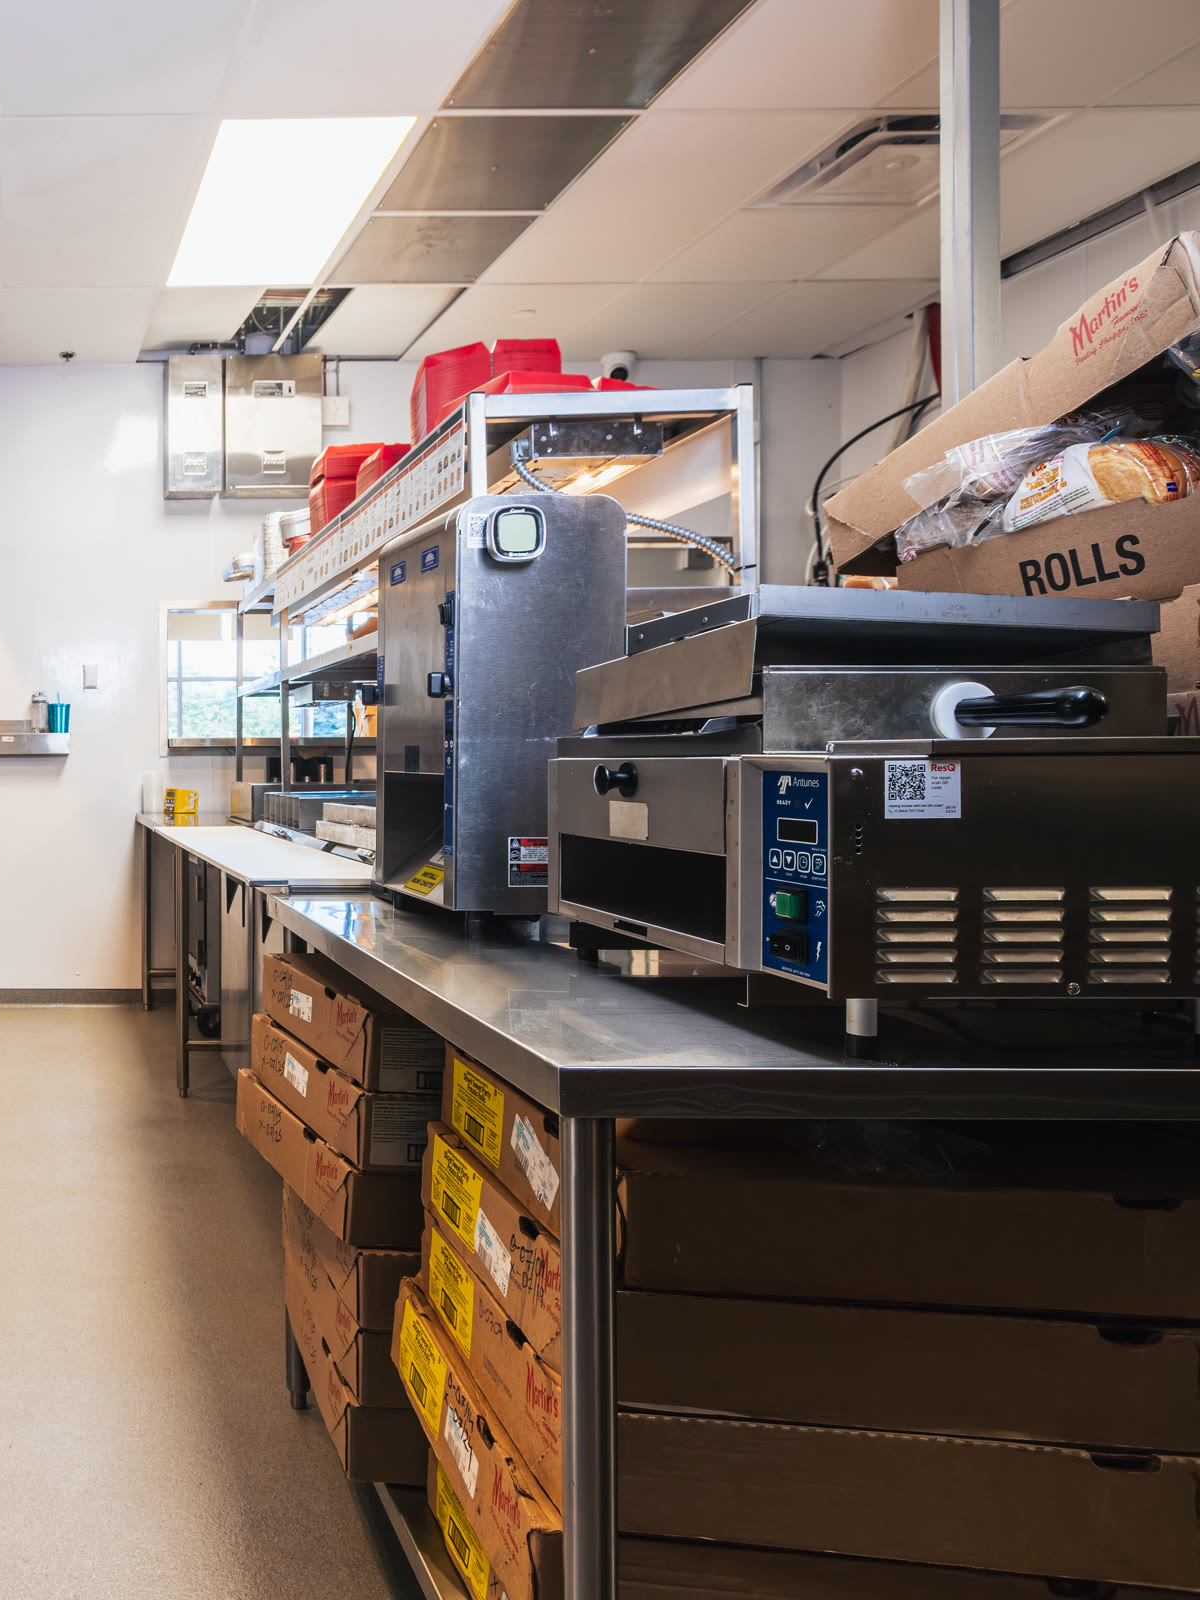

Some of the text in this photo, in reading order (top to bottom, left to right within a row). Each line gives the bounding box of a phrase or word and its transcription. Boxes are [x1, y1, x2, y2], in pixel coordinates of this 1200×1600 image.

[1069, 277, 1139, 357] Martin's
[1018, 534, 1146, 597] ROLLS
[931, 763, 956, 772] ResQ
[792, 777, 820, 788] Antunes
[419, 880, 435, 888] CHUTE
[421, 871, 439, 880] INSTALL
[336, 1001, 357, 1029] Martin's
[327, 1080, 349, 1108] Martin's
[315, 1151, 338, 1180] Martin's
[526, 1361, 559, 1418] Martin's
[492, 1463, 520, 1529] Martin's
